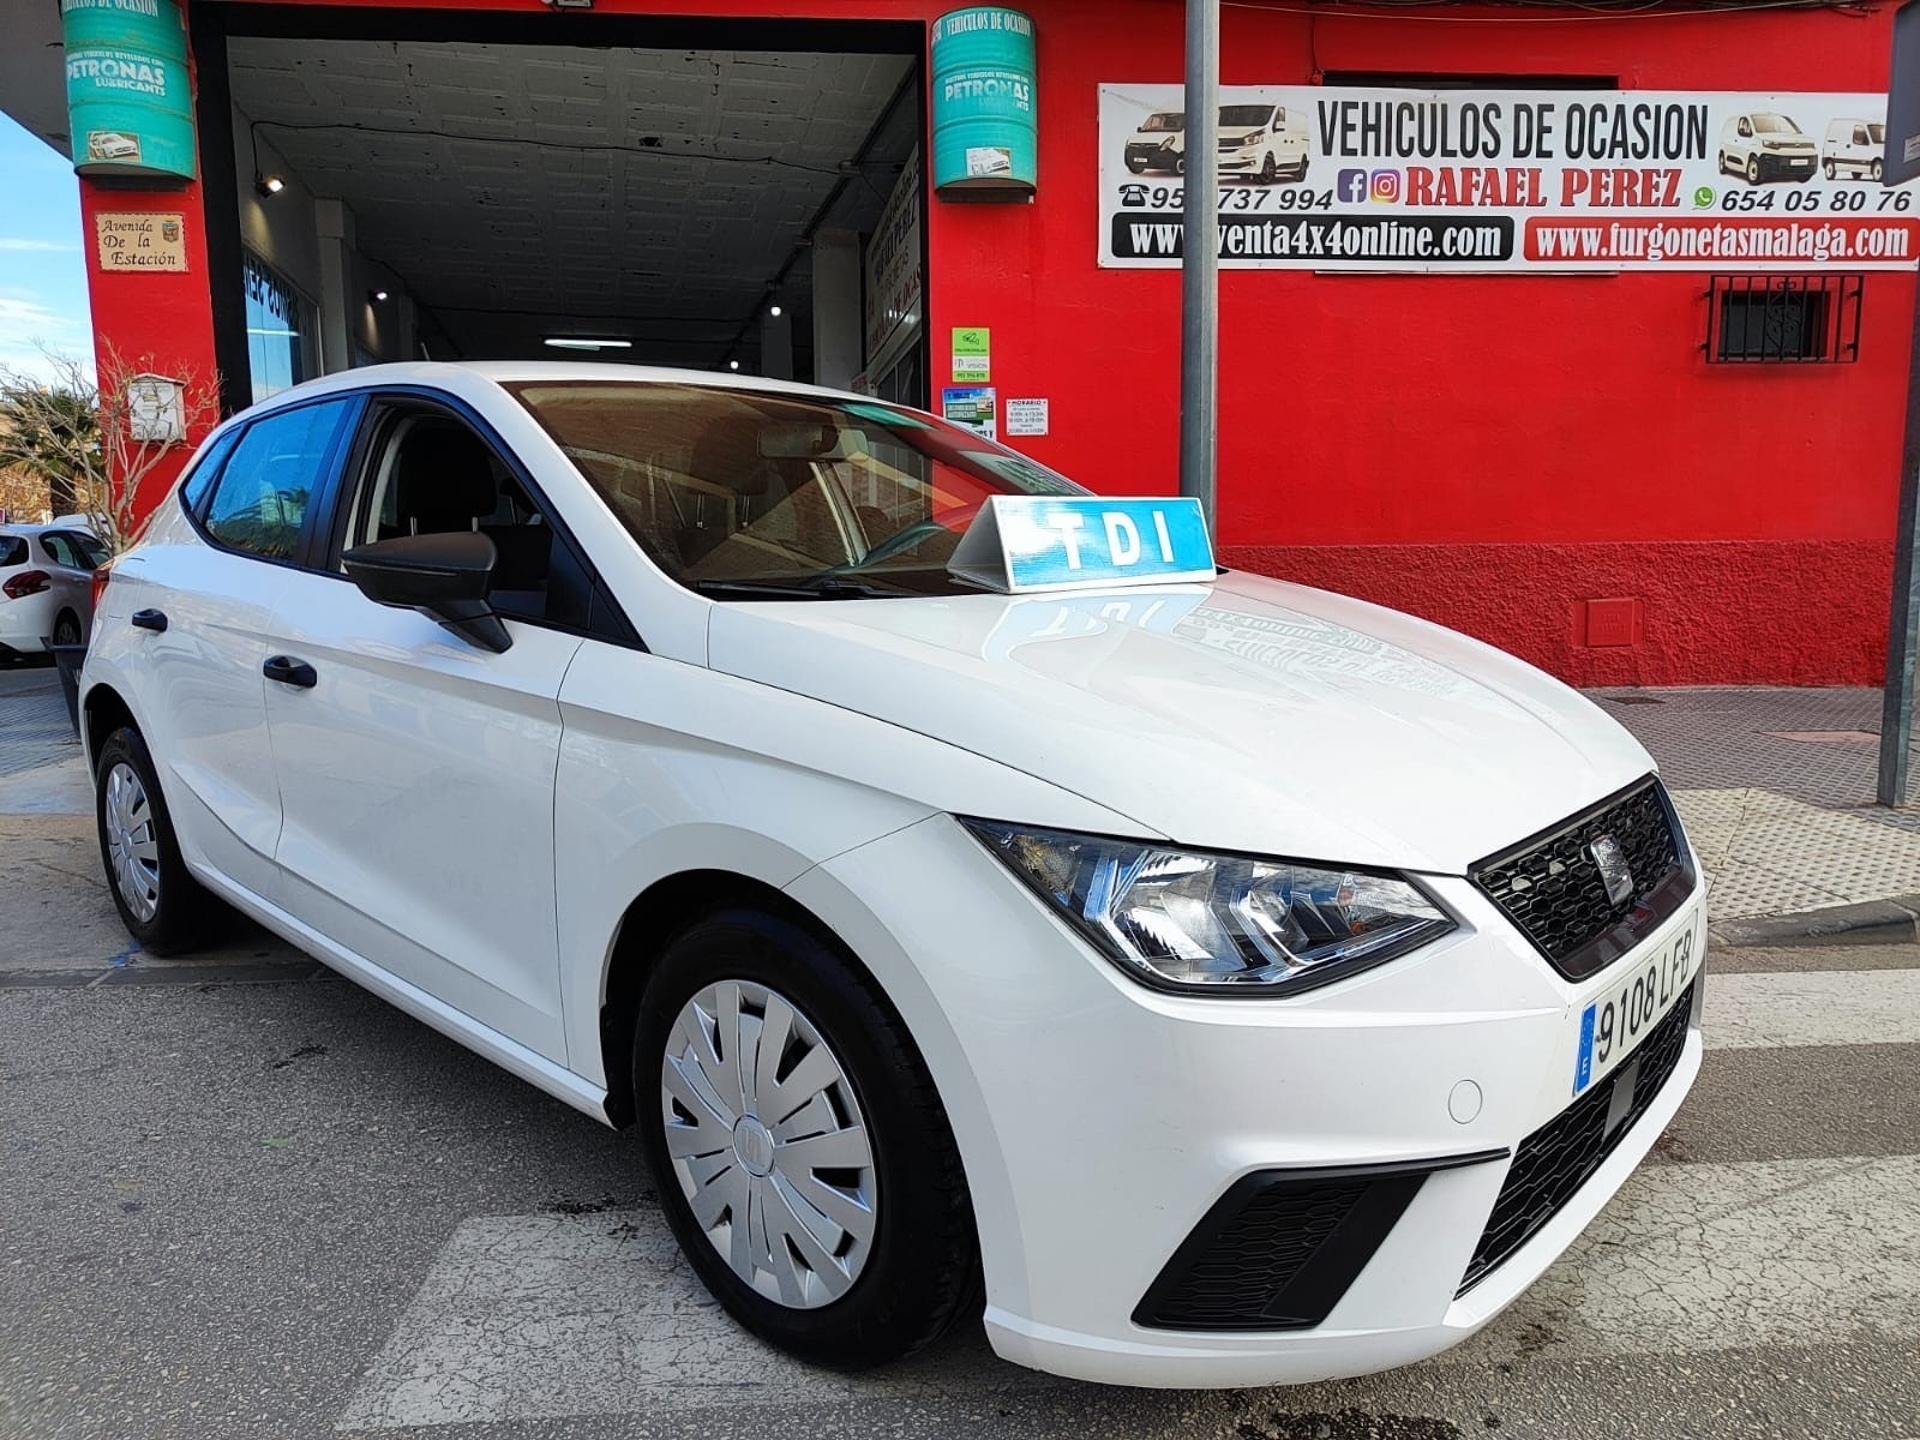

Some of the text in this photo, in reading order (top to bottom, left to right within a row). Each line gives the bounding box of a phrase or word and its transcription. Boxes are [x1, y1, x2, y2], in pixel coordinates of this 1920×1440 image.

[946, 12, 988, 37] VEHICULOS
[990, 12, 1003, 30] DE
[66, 59, 165, 86] PETRONAS
[95, 77, 166, 97] LUBRICANTS
[945, 79, 1029, 102] PETRONAS
[1317, 100, 1708, 160] VEHICULOS DE OCASION
[1151, 187, 1333, 211] 95 737 994
[1405, 166, 1683, 207] RAFAEL PEREZ
[1721, 190, 1912, 212] 654 05 80 76
[102, 219, 153, 233] Avenida
[1130, 220, 1501, 257] wwventa4x4online.com
[103, 232, 151, 248] De la
[1536, 222, 1909, 261] www.furgonetasmalaga.com
[110, 251, 176, 266] Estación
[1045, 509, 1176, 571] TDI
[1597, 928, 1692, 1064] 9108 LFB
